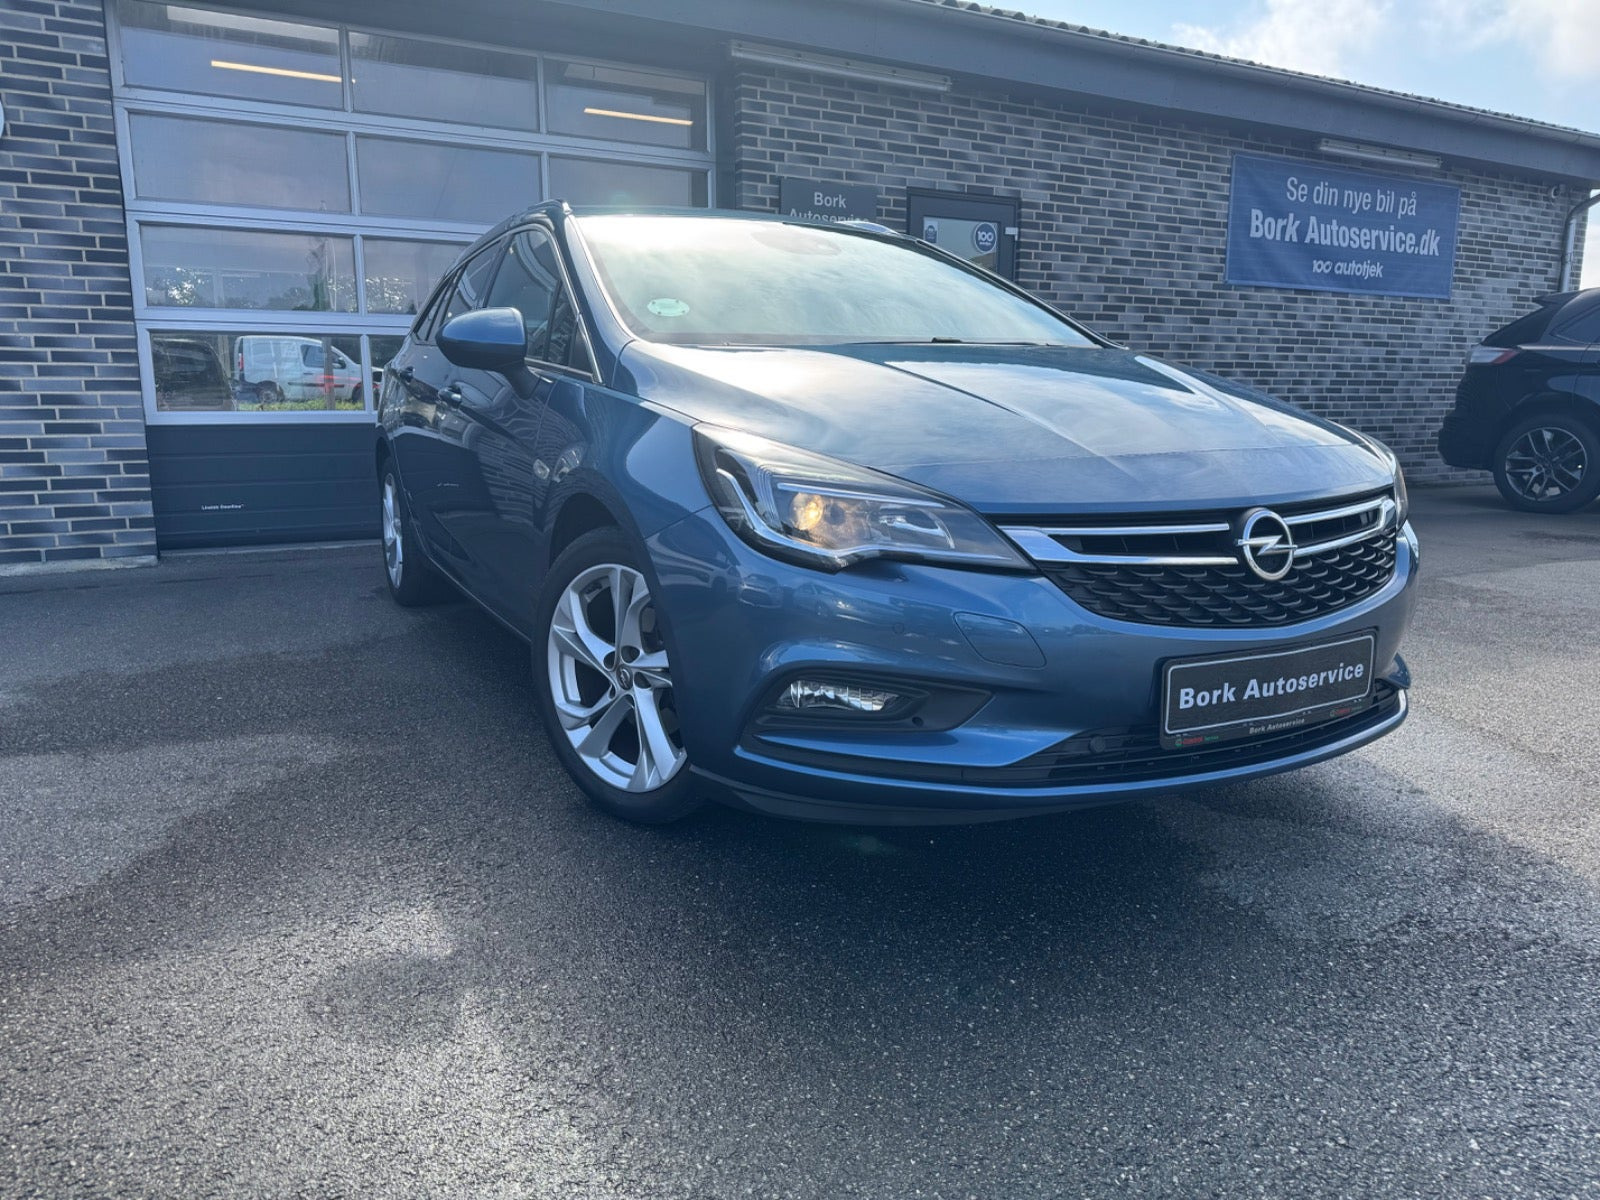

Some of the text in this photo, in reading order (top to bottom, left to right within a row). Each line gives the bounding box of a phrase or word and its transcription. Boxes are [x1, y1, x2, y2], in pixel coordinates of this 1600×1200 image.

[814, 191, 846, 208] Bork
[1286, 177, 1416, 219] Se din nye bil på
[977, 230, 994, 242] 100
[1250, 208, 1440, 256] Bork Autoservice.dk
[1334, 260, 1383, 280] autotjek
[1179, 662, 1364, 709] Bork Autoservice
[1249, 726, 1266, 735] Bork
